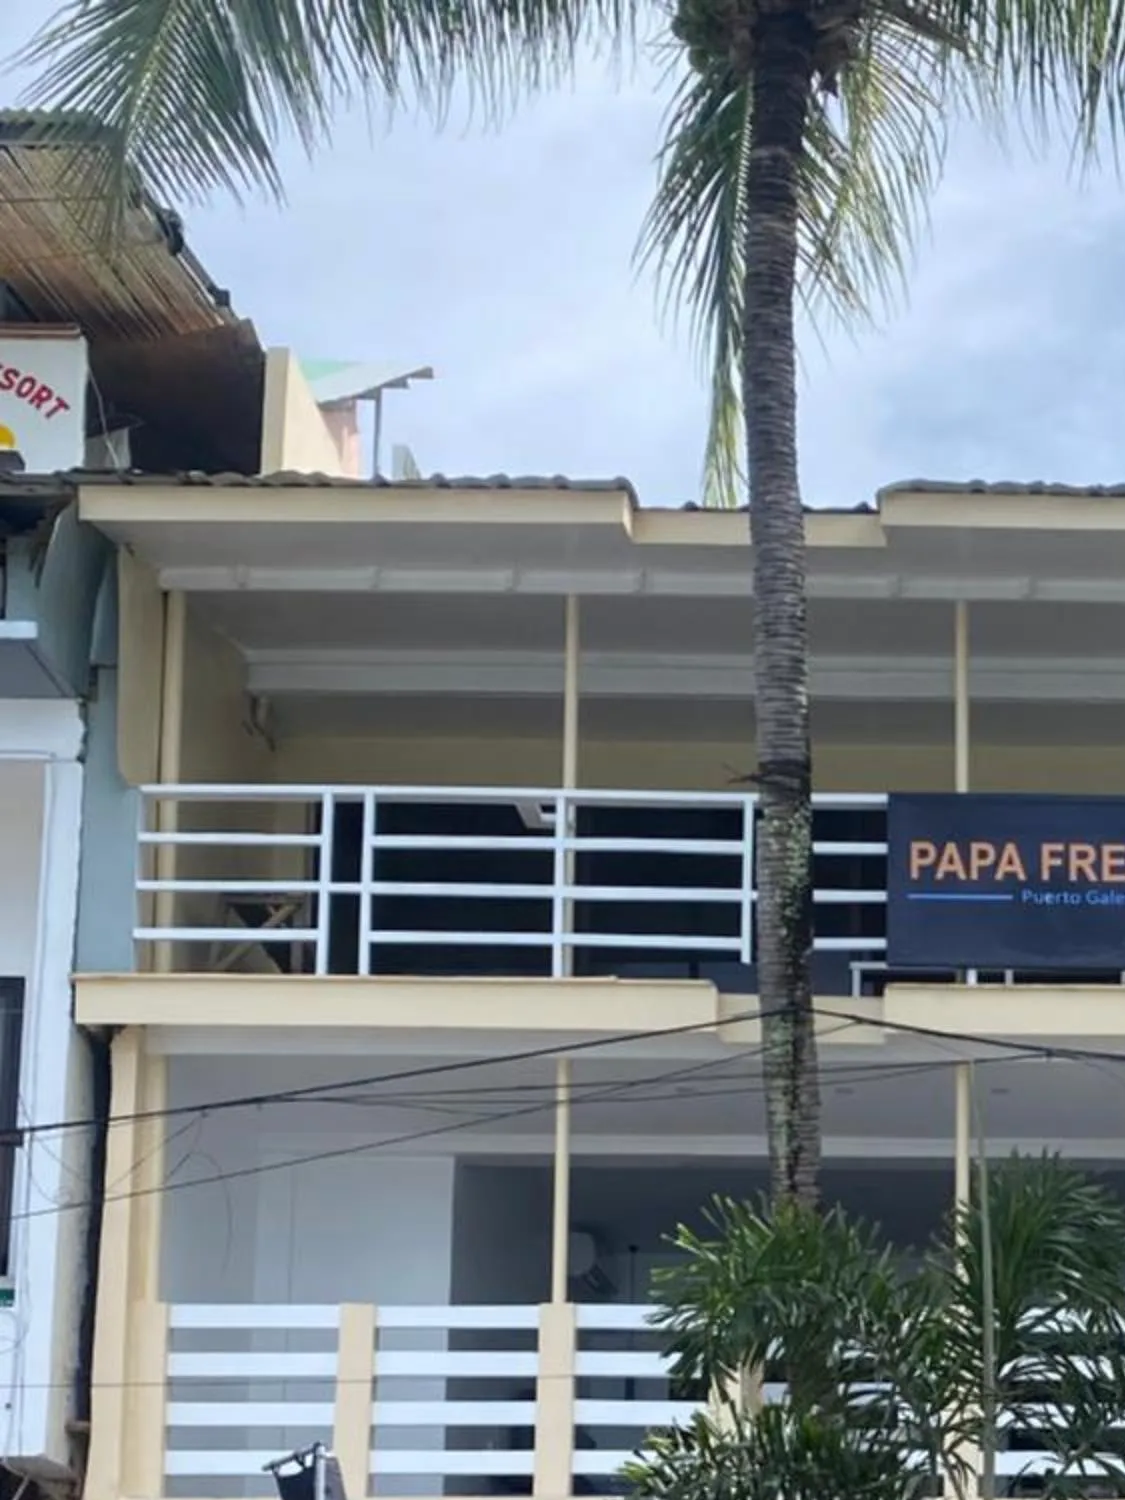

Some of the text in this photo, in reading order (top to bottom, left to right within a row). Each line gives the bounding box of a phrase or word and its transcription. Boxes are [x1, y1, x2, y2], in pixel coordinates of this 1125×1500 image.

[0, 363, 70, 419] SORT
[909, 841, 1026, 881] PAPA
[1022, 889, 1082, 905] Puerto
